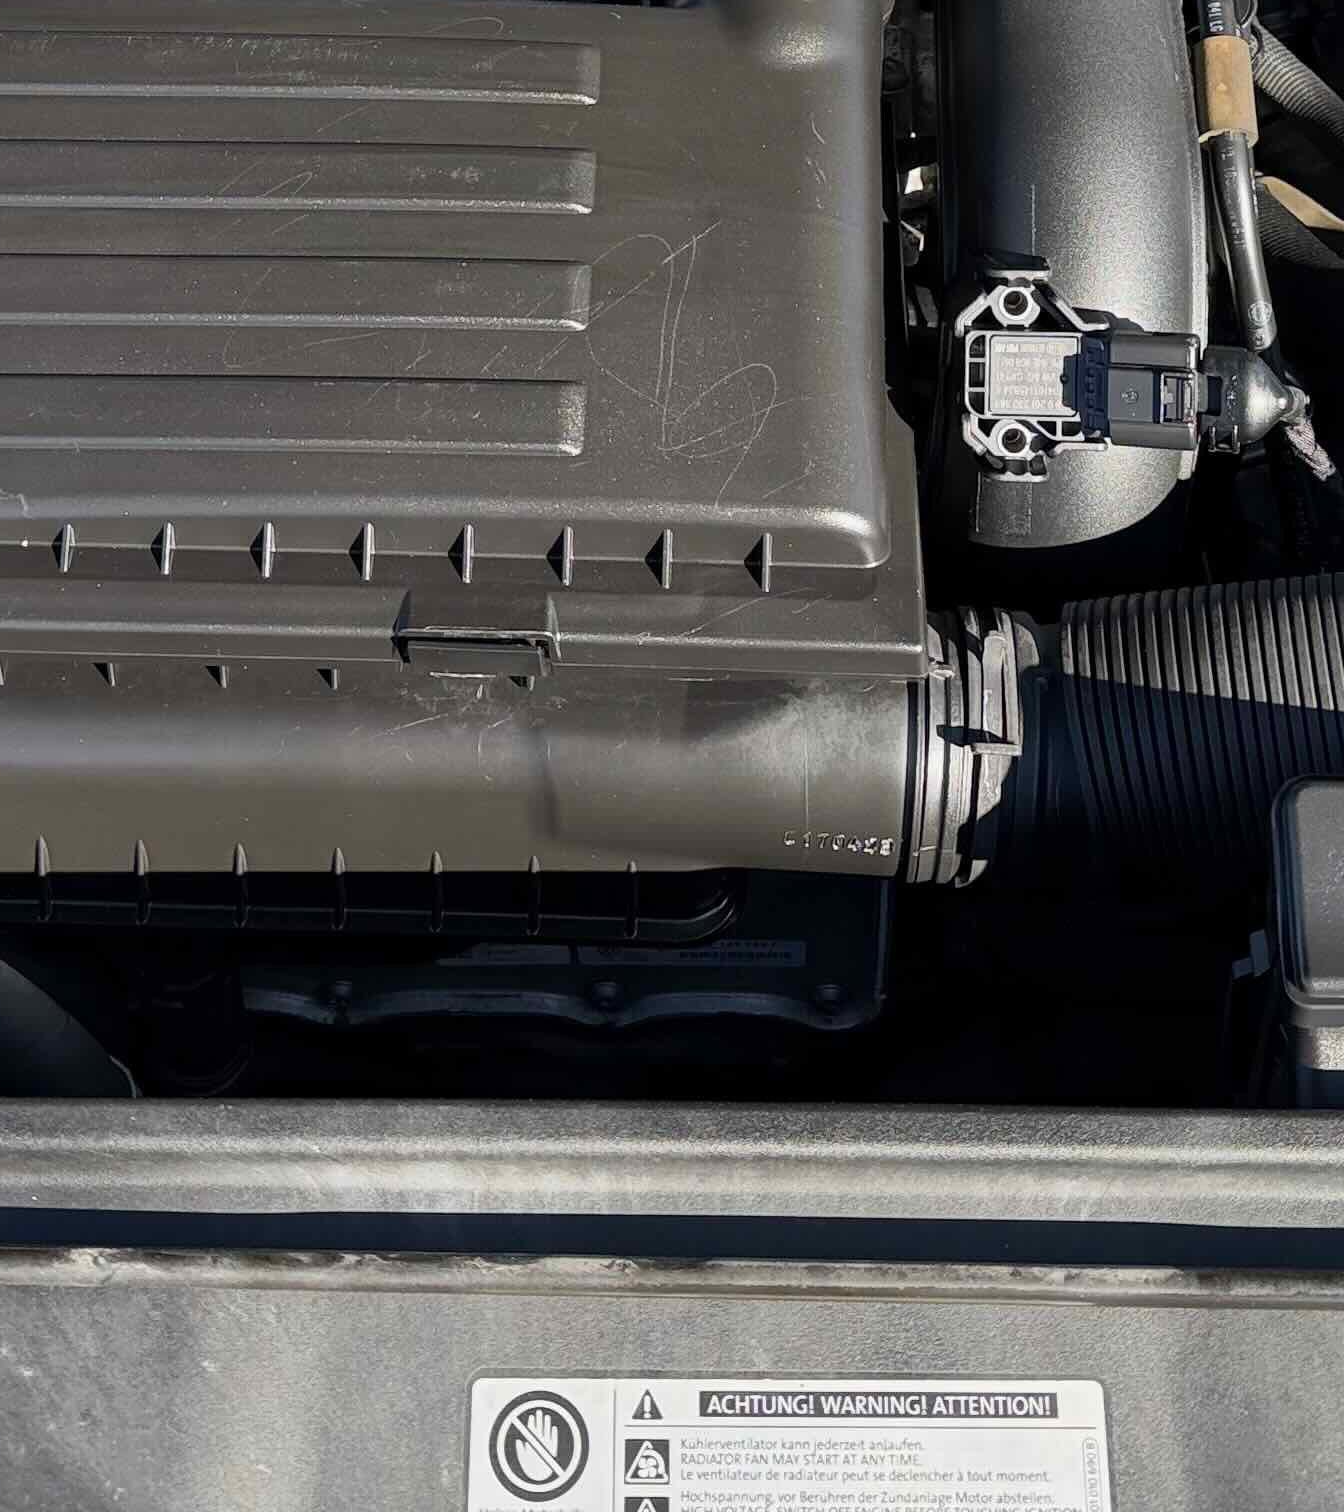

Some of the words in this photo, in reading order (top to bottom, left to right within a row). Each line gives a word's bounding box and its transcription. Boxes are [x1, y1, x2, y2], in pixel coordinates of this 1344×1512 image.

[706, 1394, 815, 1415] ACHTUNG!
[821, 1394, 927, 1416] WARNING!
[932, 1395, 1051, 1416] ATTENTION!
[781, 1437, 810, 1450] kann
[813, 1437, 865, 1454] jederzeit
[680, 1453, 742, 1465] RADIATOR
[745, 1453, 769, 1465] FAN
[772, 1453, 800, 1465] MAY
[804, 1453, 840, 1465] START
[842, 1453, 857, 1465] AT
[861, 1453, 886, 1465] ANY
[680, 1469, 694, 1481] Le
[697, 1469, 762, 1481] ventilateur
[765, 1469, 779, 1481] de
[783, 1469, 838, 1481] radiateur
[841, 1470, 870, 1485] peut
[873, 1472, 886, 1481] se
[967, 1470, 994, 1482] tout
[778, 1493, 796, 1503] vor
[858, 1490, 877, 1504] der
[956, 1491, 994, 1504] Motor
